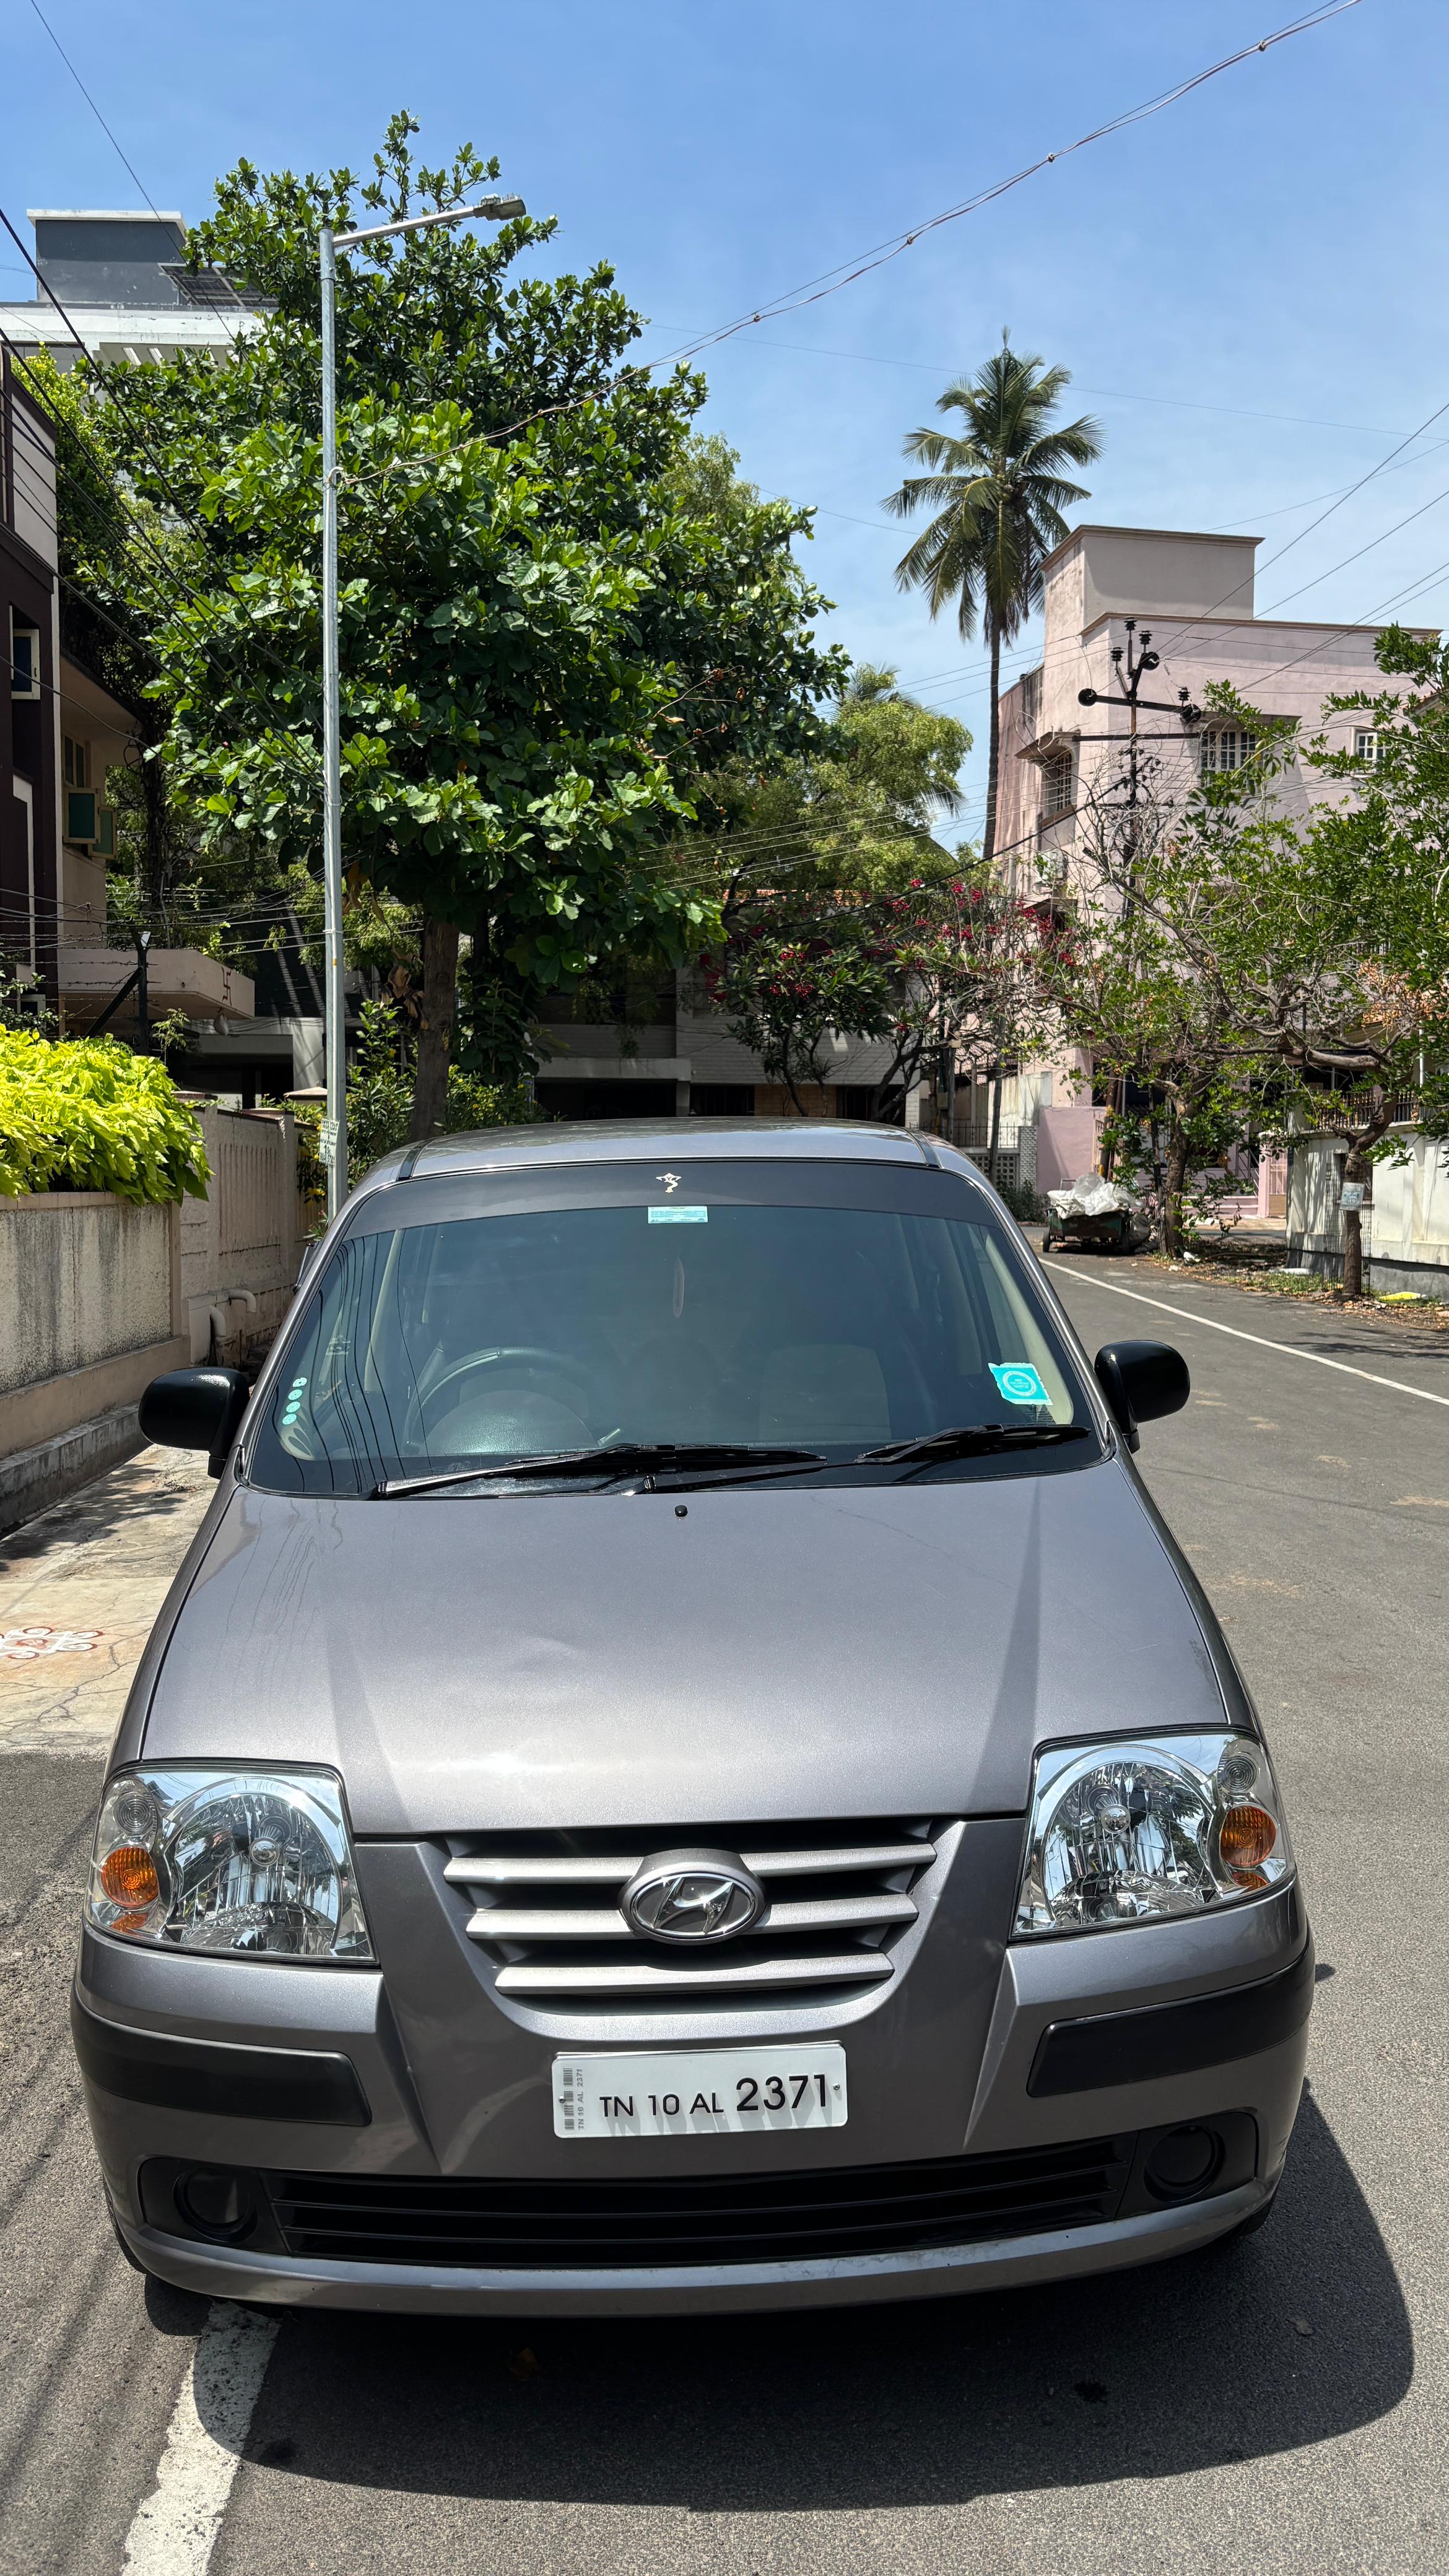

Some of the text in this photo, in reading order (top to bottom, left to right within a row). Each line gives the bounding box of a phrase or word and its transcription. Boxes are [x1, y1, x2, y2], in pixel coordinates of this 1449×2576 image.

[577, 2091, 584, 2103] AL
[599, 2073, 827, 2117] TN 10 AL 2371
[577, 2107, 584, 2116] 10
[578, 2118, 585, 2130] TN
